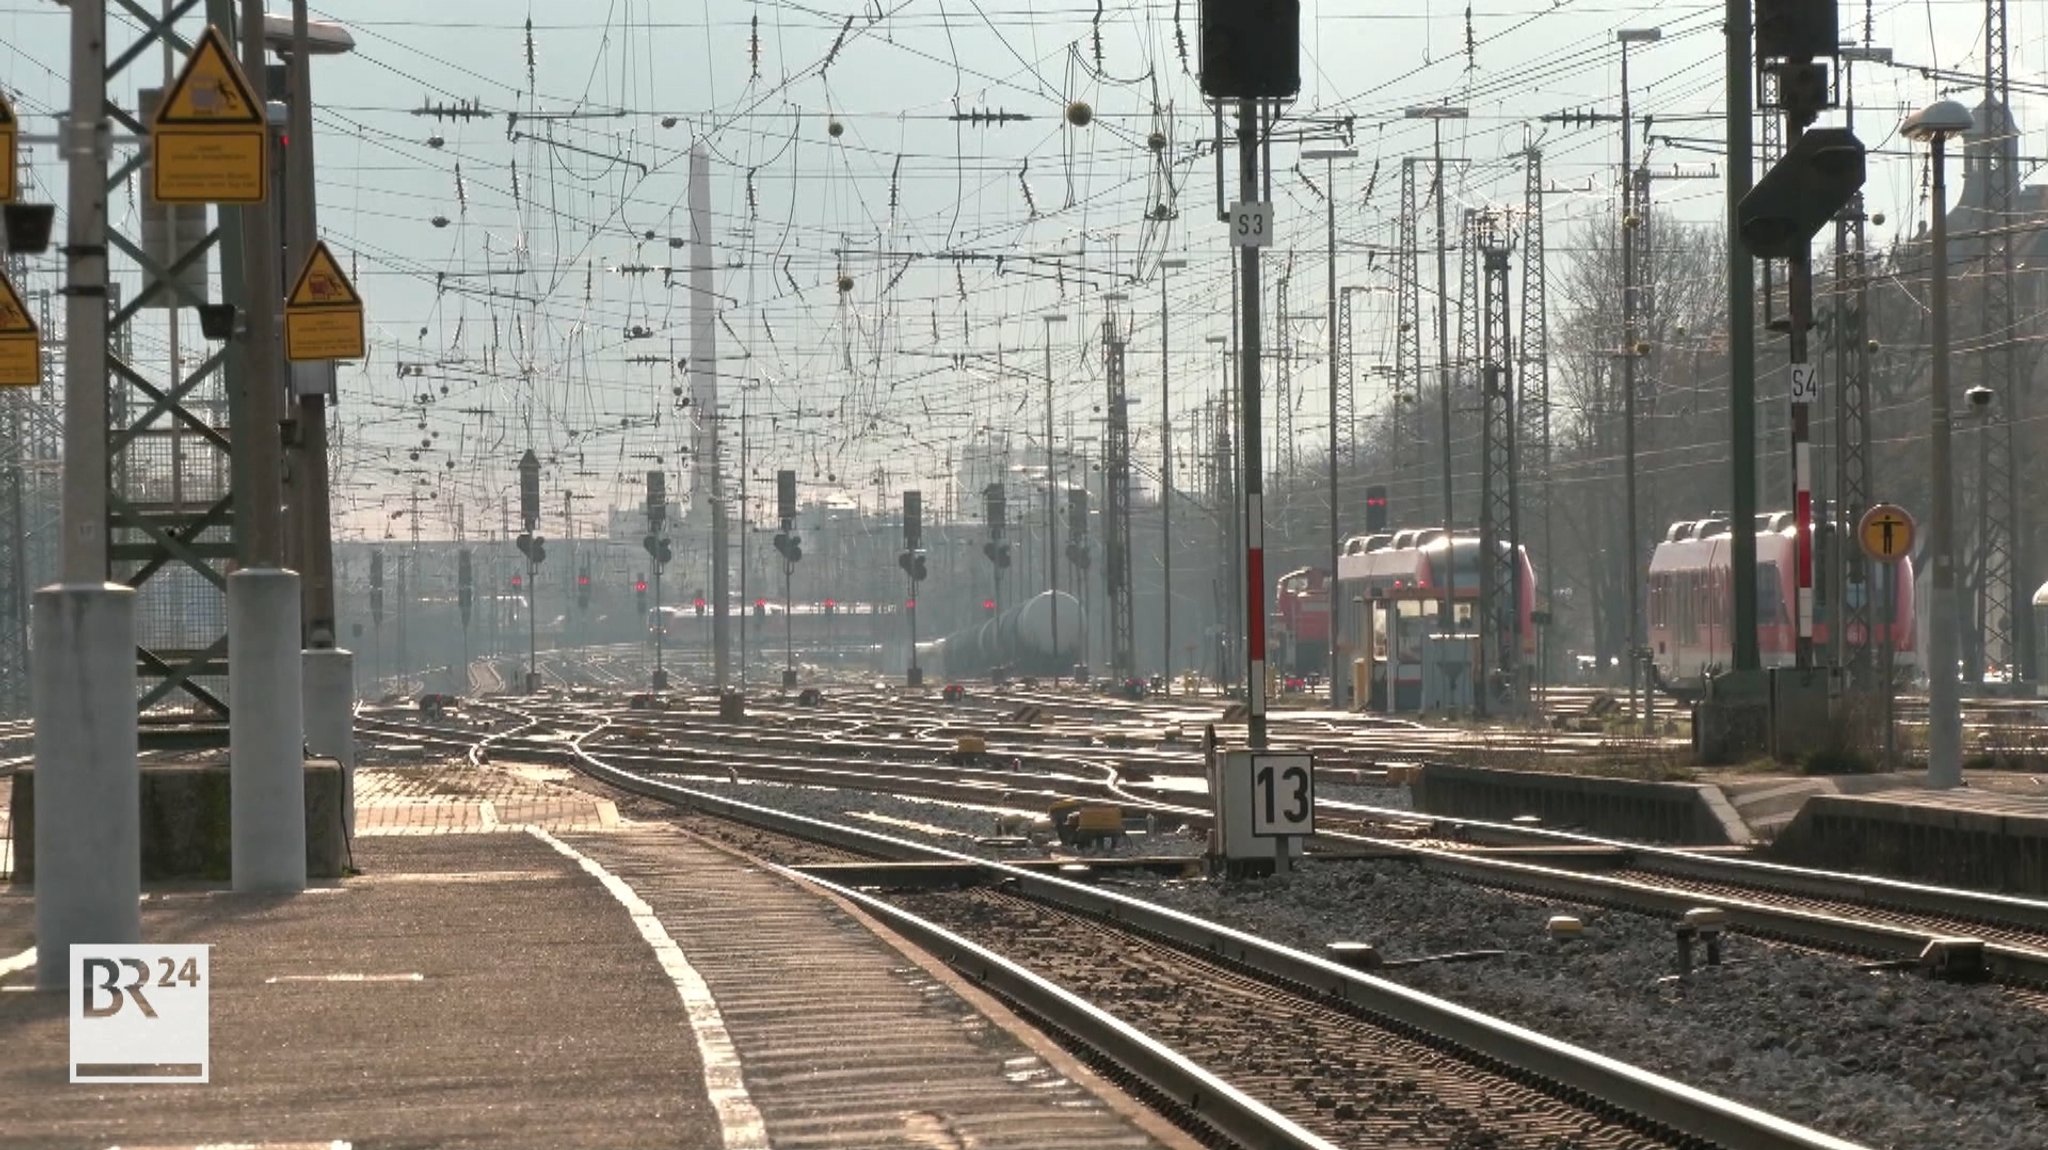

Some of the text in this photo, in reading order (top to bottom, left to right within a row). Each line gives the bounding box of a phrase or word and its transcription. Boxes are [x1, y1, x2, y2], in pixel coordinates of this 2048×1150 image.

[1238, 214, 1263, 236] S3
[1793, 369, 1816, 397] S4
[1257, 766, 1309, 824] 13
